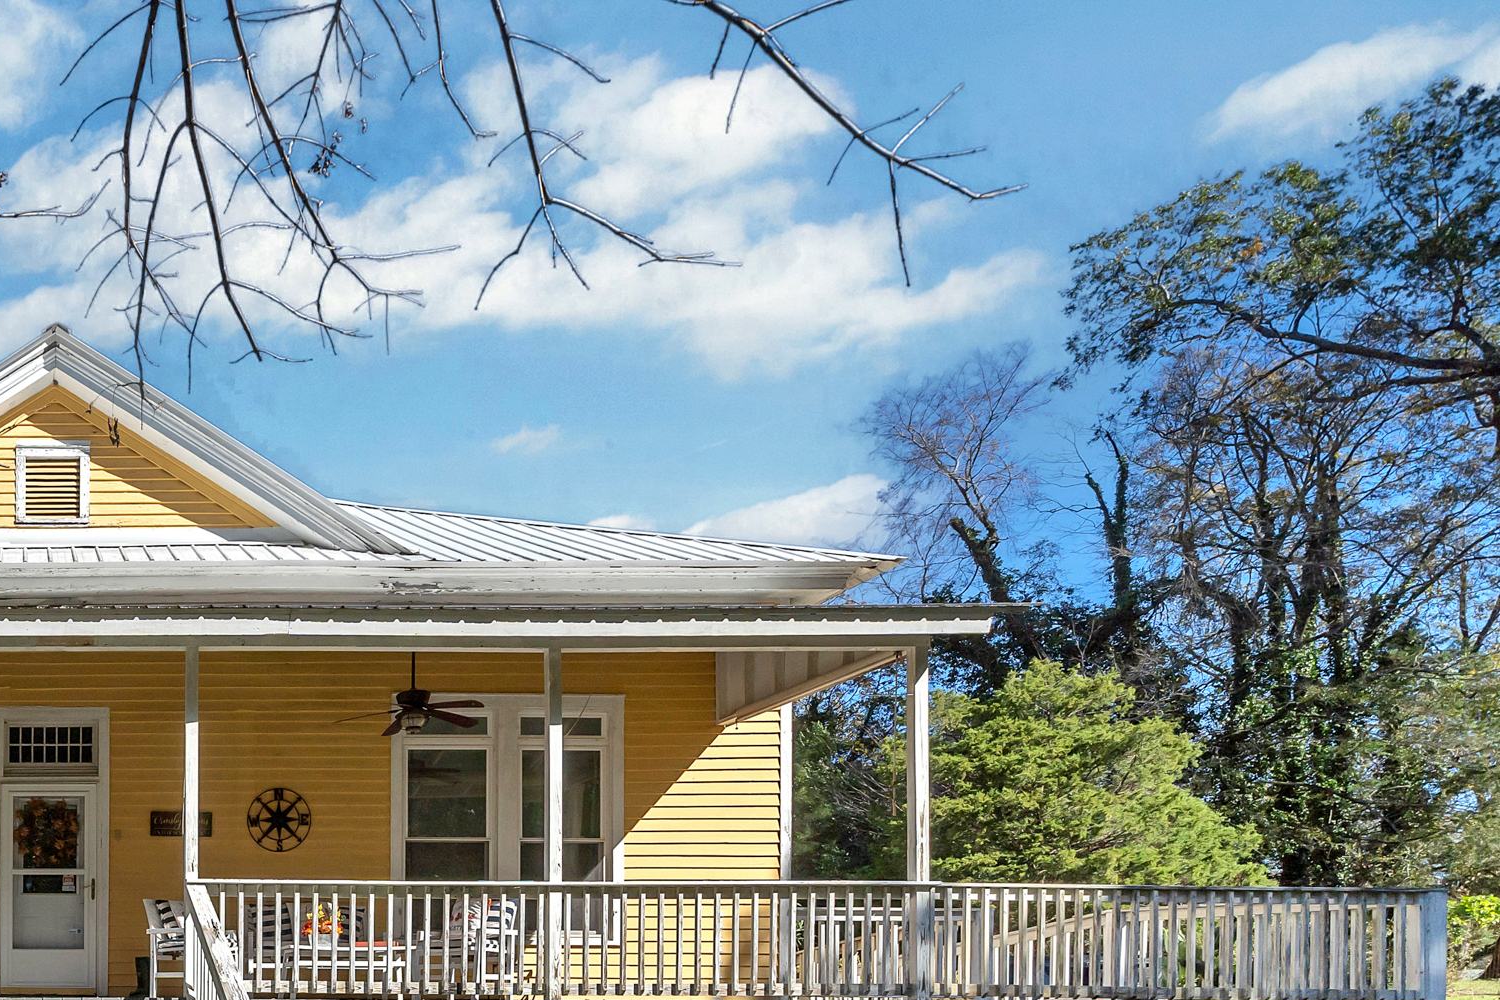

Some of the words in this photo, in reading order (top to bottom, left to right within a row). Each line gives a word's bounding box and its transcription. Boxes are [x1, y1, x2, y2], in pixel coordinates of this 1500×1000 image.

[274, 788, 284, 800] N
[248, 814, 260, 827] W
[300, 813, 309, 826] E
[276, 839, 283, 852] S
